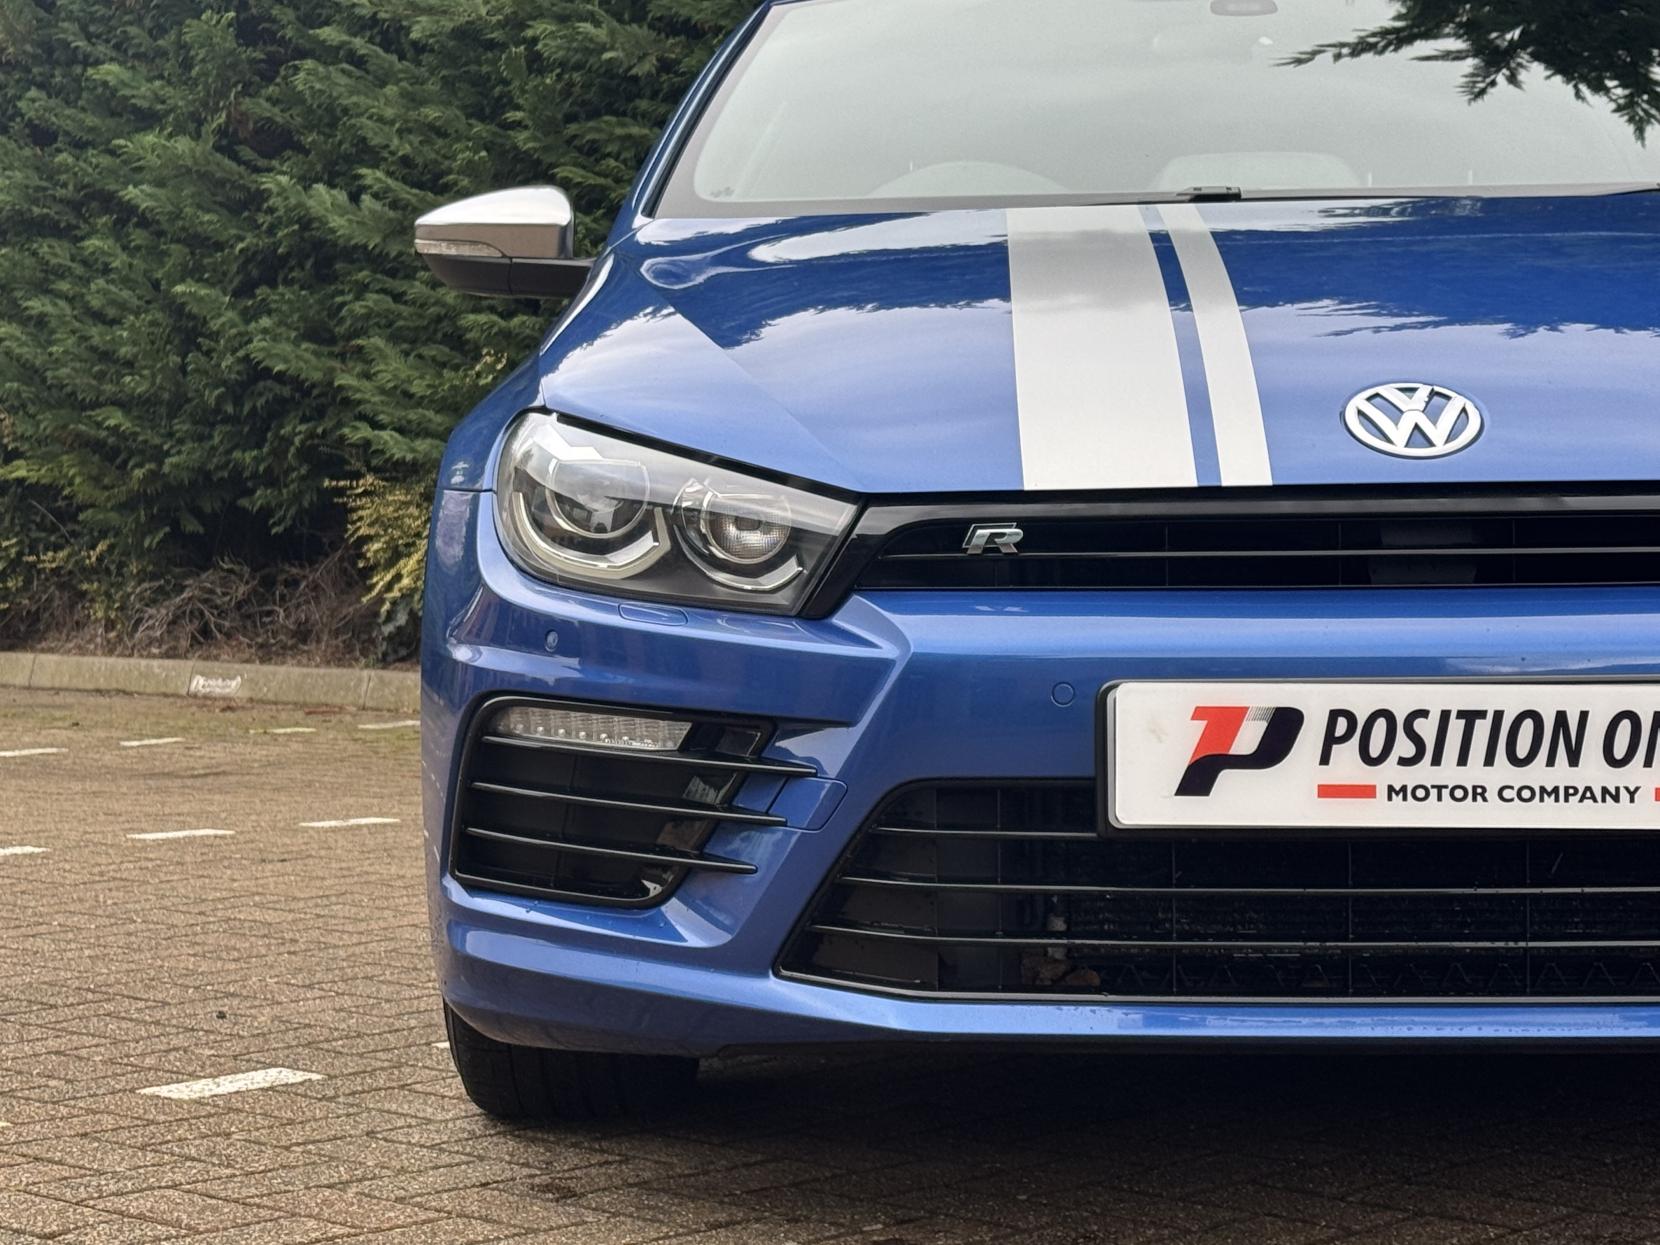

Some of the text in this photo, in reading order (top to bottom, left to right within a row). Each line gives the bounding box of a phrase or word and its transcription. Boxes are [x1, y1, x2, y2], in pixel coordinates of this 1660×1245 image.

[964, 524, 1024, 555] R
[1318, 708, 1589, 767] POSITION
[1386, 784, 1642, 804] MOTOR COMPANY
